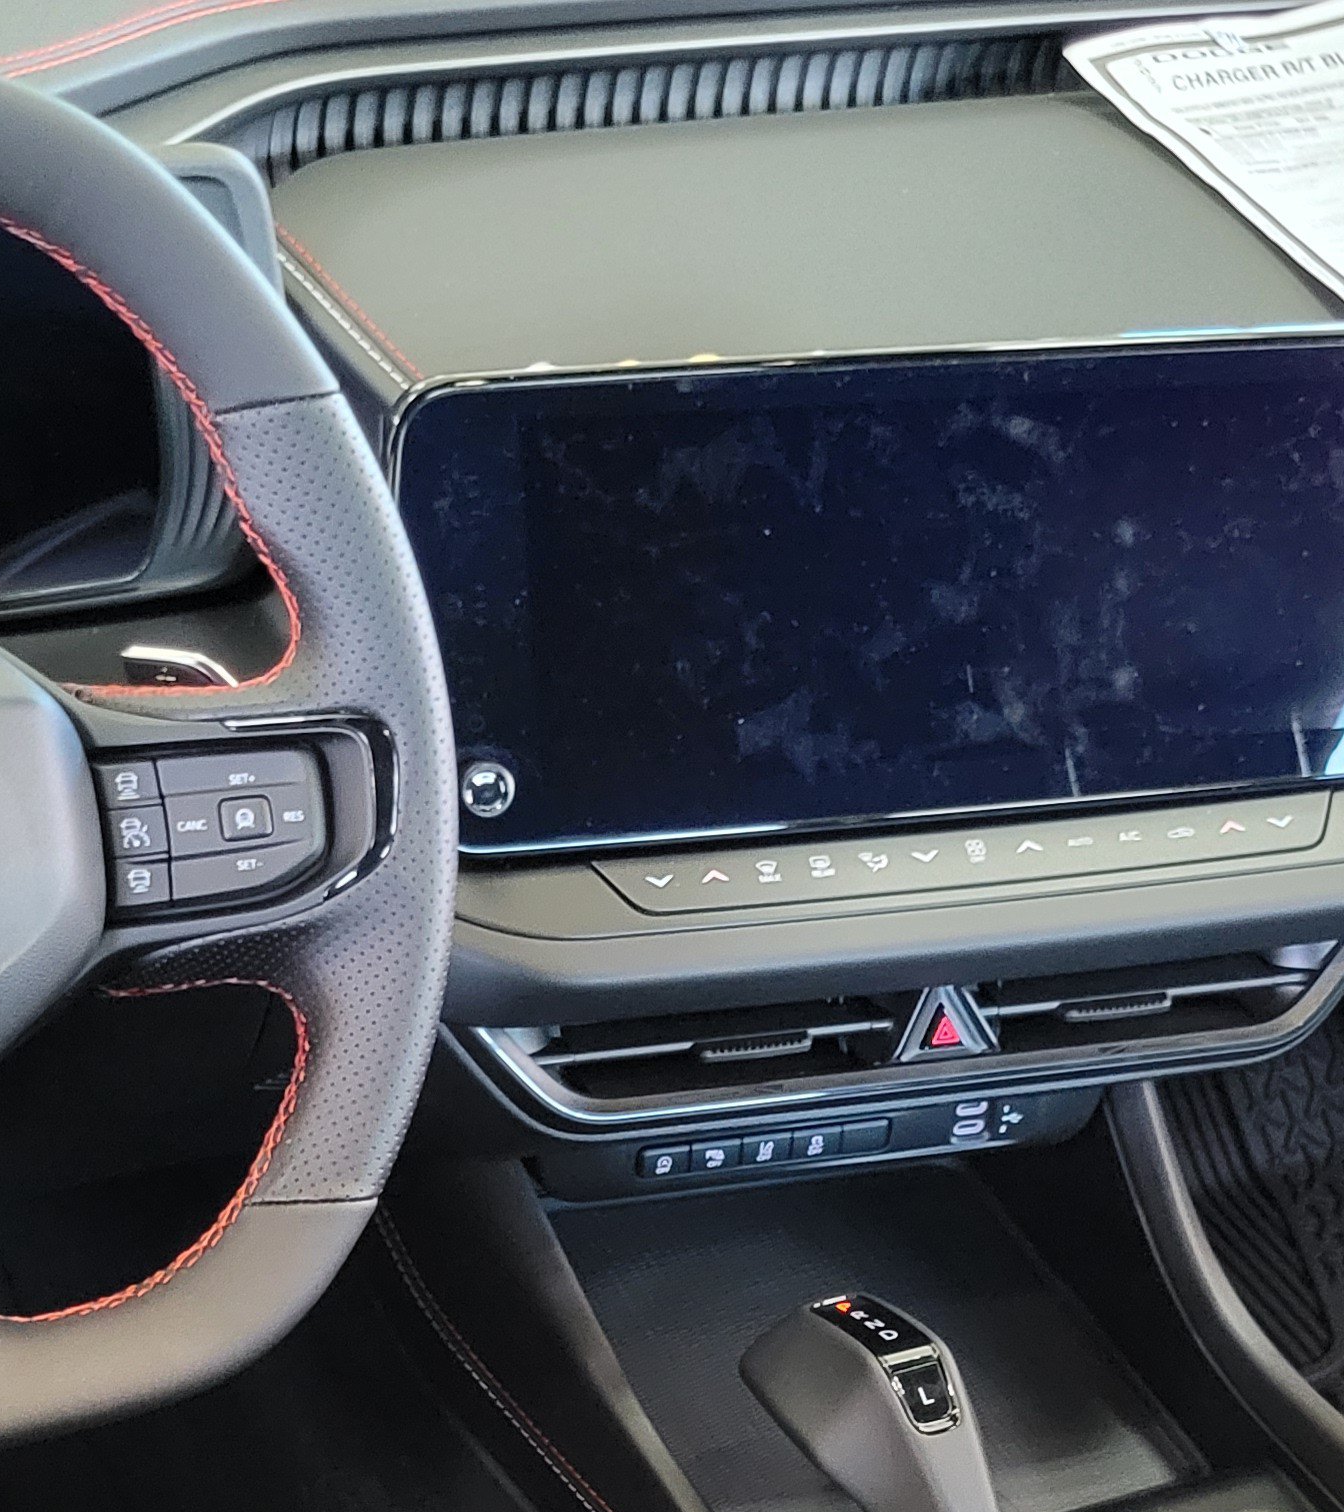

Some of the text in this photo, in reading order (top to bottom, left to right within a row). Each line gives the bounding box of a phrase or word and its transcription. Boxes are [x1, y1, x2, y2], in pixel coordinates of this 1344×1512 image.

[1172, 64, 1282, 92] CHARGER
[1283, 56, 1318, 78] R/T
[864, 1319, 886, 1330] N
[878, 1329, 899, 1341] D
[917, 1386, 935, 1405] L
